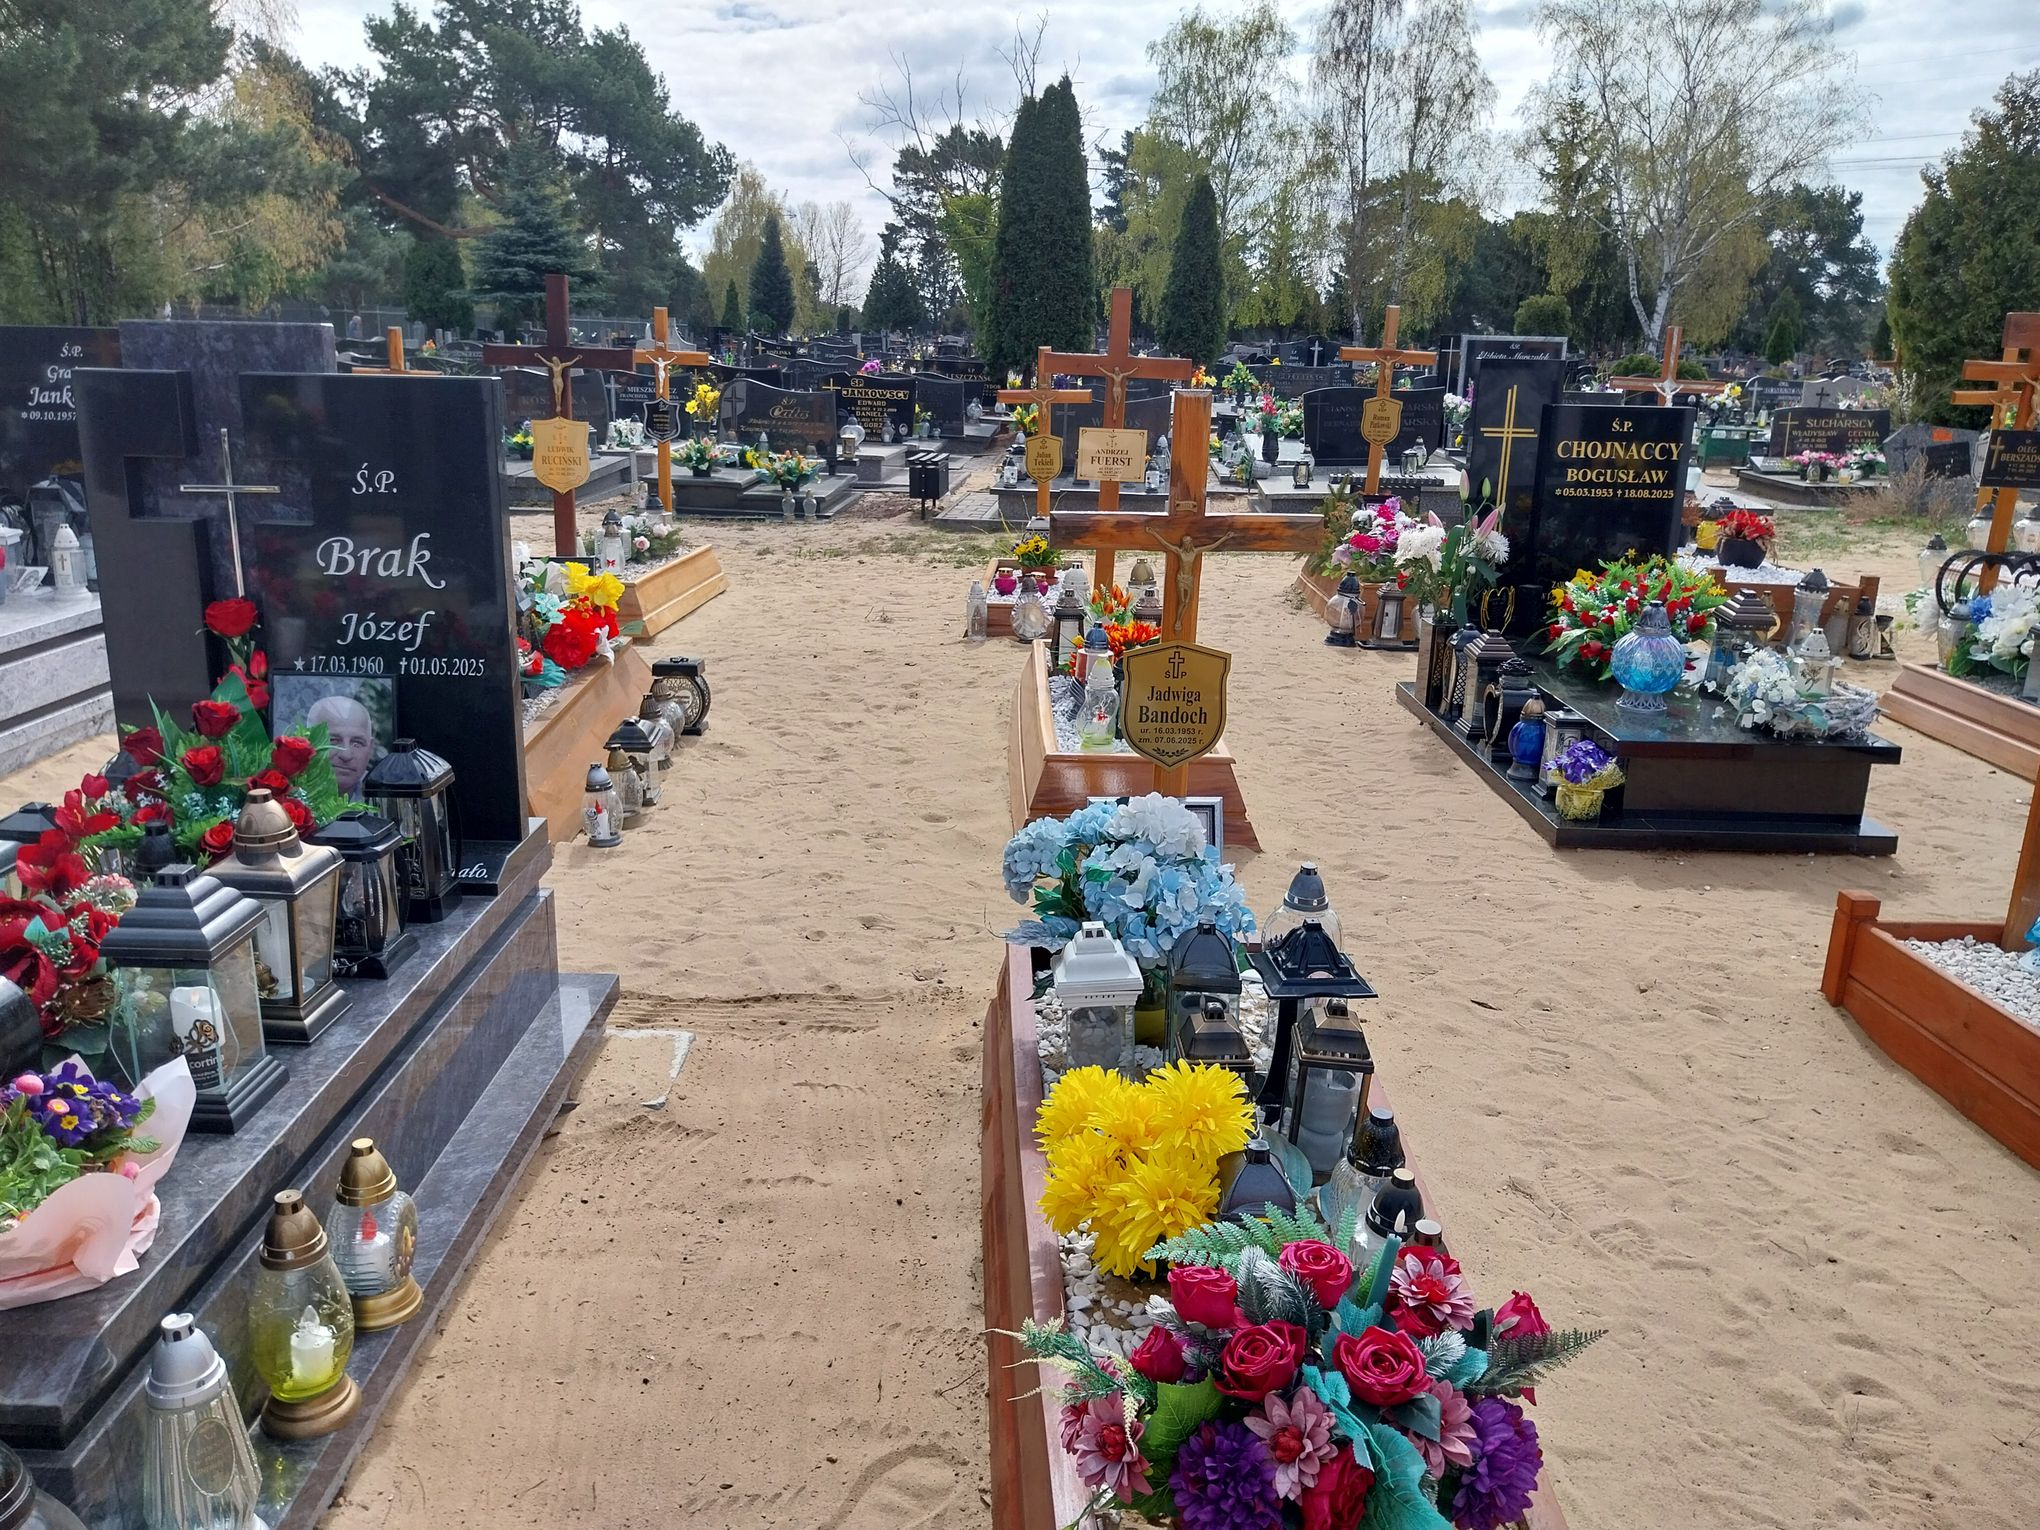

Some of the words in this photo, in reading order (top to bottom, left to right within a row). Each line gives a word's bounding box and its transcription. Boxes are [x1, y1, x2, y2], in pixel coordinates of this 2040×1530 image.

[60, 342, 83, 357] Ś.P.
[28, 385, 76, 408] Jank
[842, 388, 910, 400] JANKOWSCY
[1611, 417, 1634, 432] Ś.P.
[1806, 419, 1875, 429] SUCHARSCY
[1557, 440, 1684, 461] CHOJNACCY
[2017, 445, 2037, 453] OLEG
[1091, 456, 1133, 466] FUERST
[351, 463, 398, 495] Ś.P.
[1566, 468, 1668, 484] BOGUSŁAW
[1563, 487, 1613, 497] 05.03.1953
[1624, 489, 1674, 498] 18.08.2025
[316, 532, 446, 589] Brak
[336, 610, 436, 652] Józef
[310, 655, 384, 674] 17.03.1960
[410, 658, 485, 676] 01.05.2025
[1147, 686, 1201, 706] Jadwiga
[1138, 705, 1208, 724] Bandoch
[1154, 727, 1196, 735] 16.03.1953
